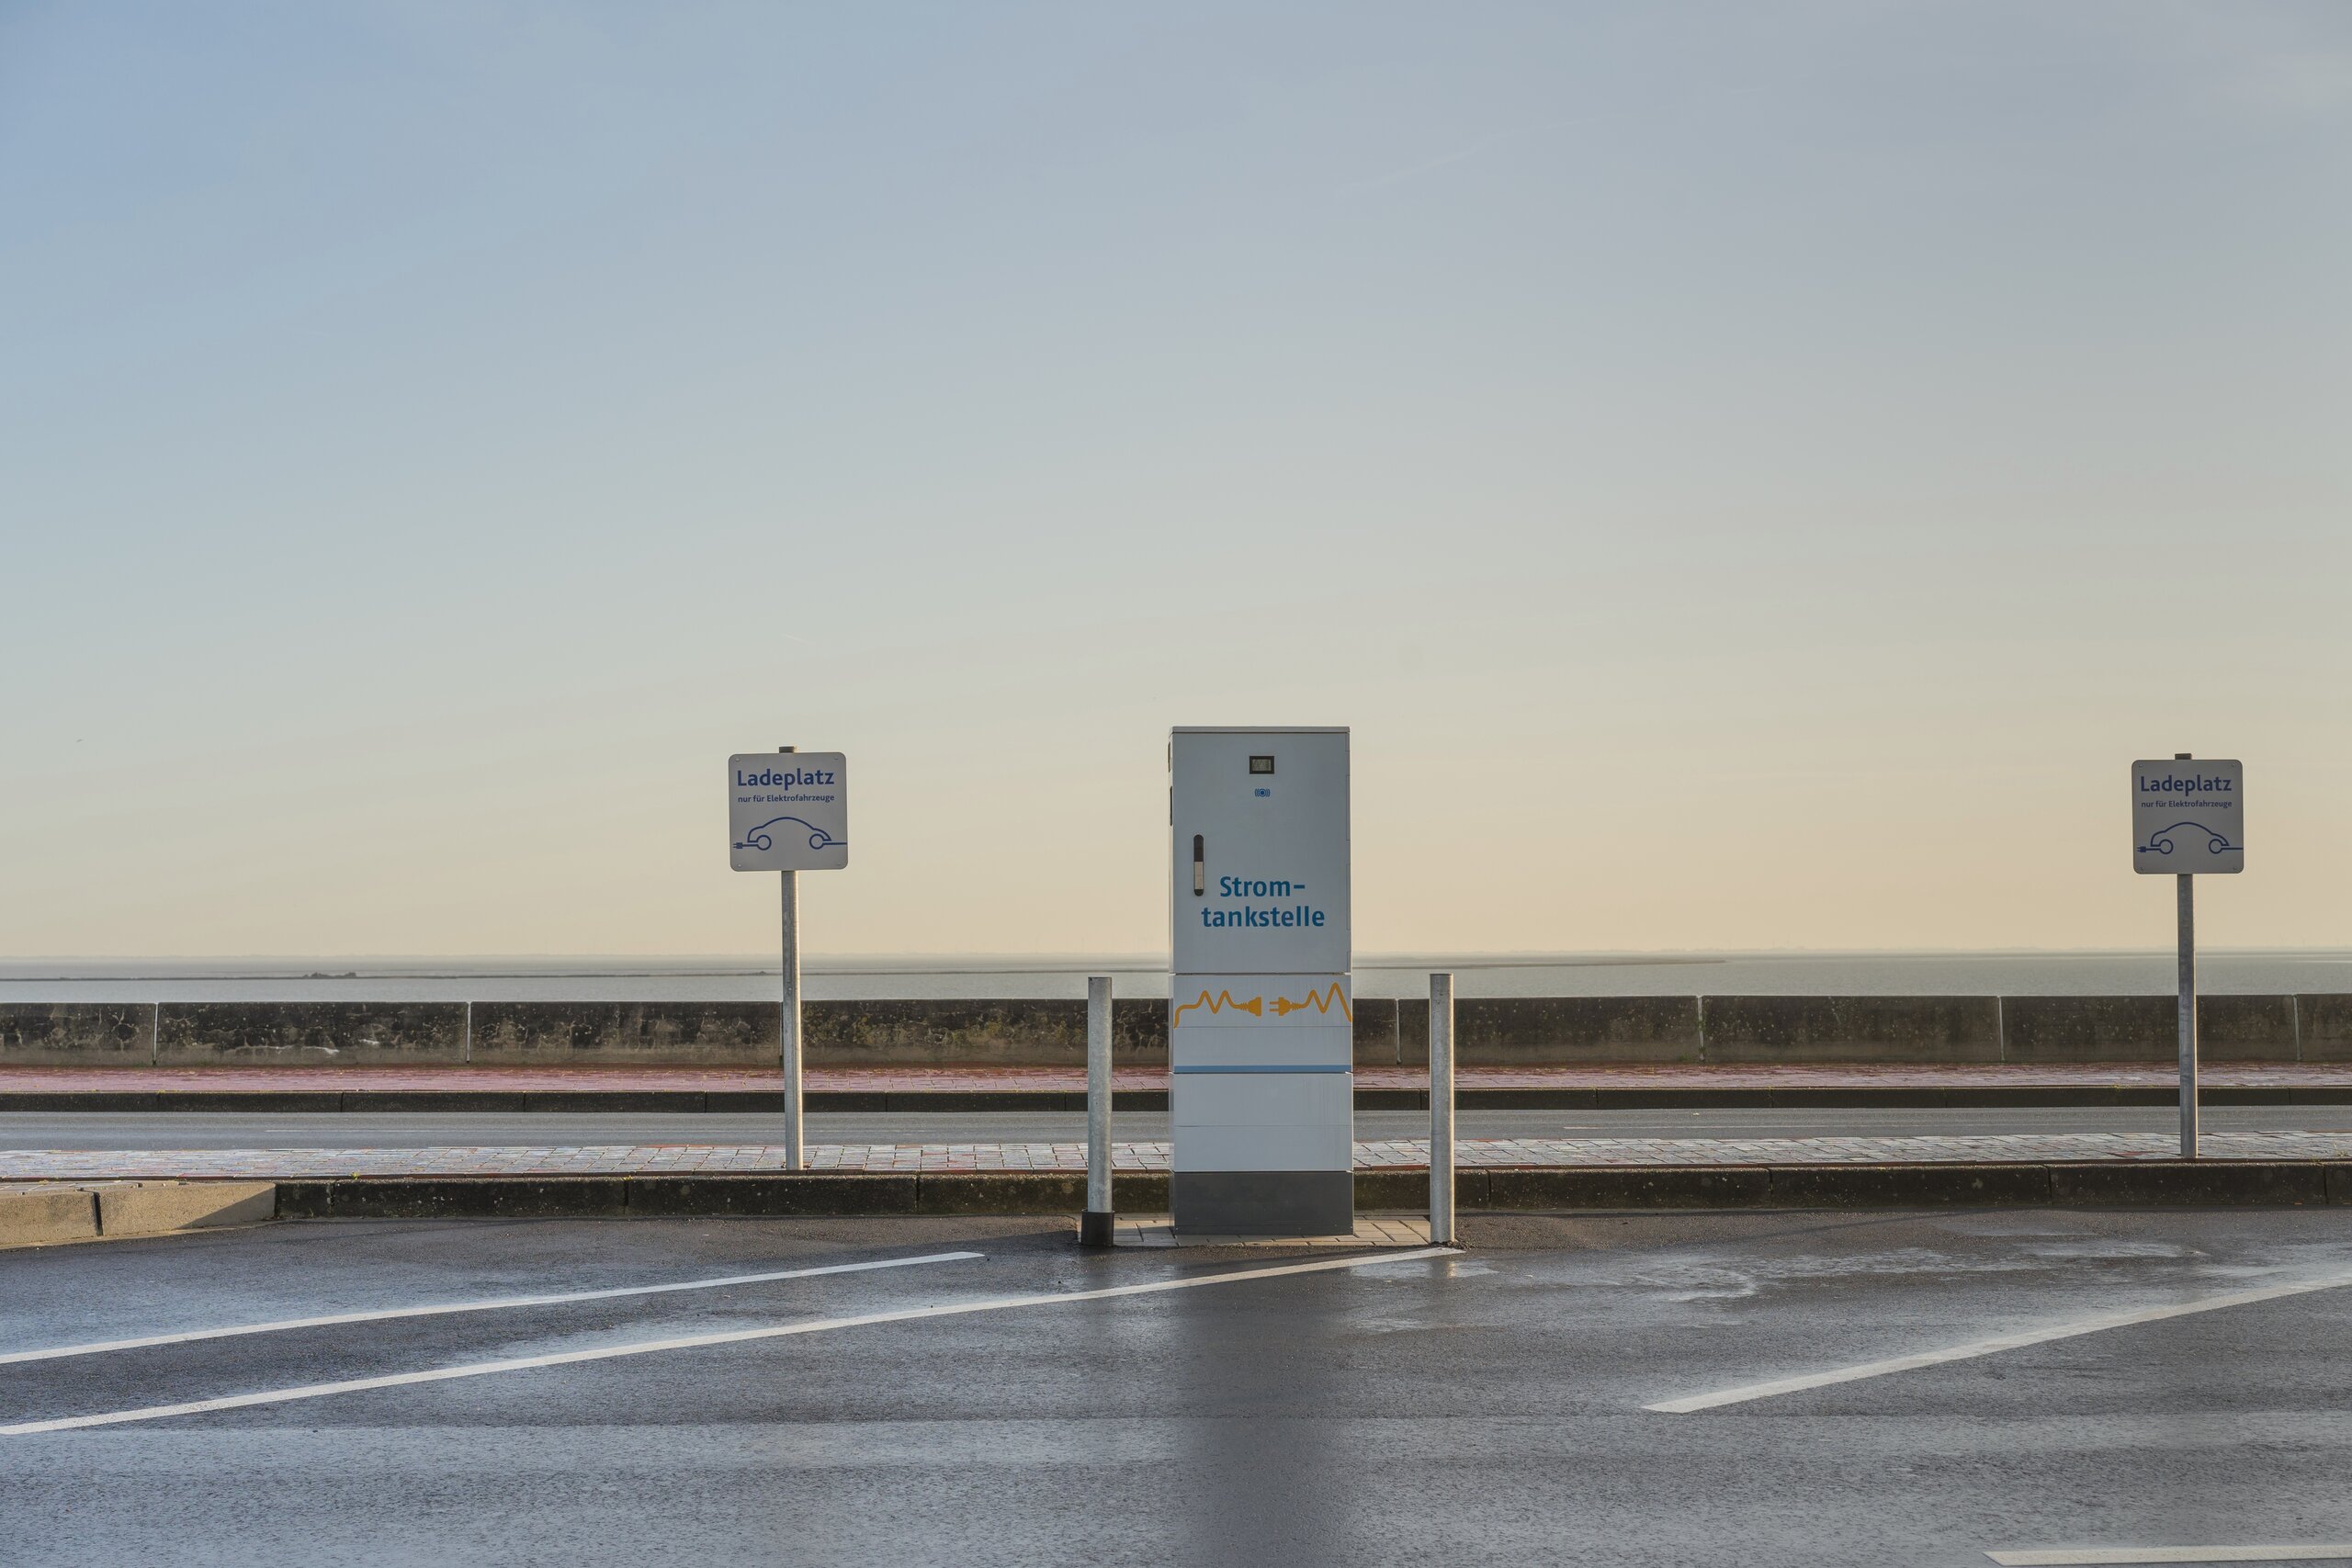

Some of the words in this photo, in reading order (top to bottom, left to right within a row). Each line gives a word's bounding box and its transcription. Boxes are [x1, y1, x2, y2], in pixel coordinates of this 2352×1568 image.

[738, 767, 835, 791] Ladeplatz
[2140, 774, 2233, 796] Ladeplatz
[752, 795, 765, 803] für
[767, 794, 835, 804] Elektrofahrzeuge
[2155, 800, 2167, 808] für
[2168, 800, 2233, 809] Elektrofahrzeuge
[1219, 875, 1306, 897] Strom-
[1201, 906, 1325, 928] tankstelle
